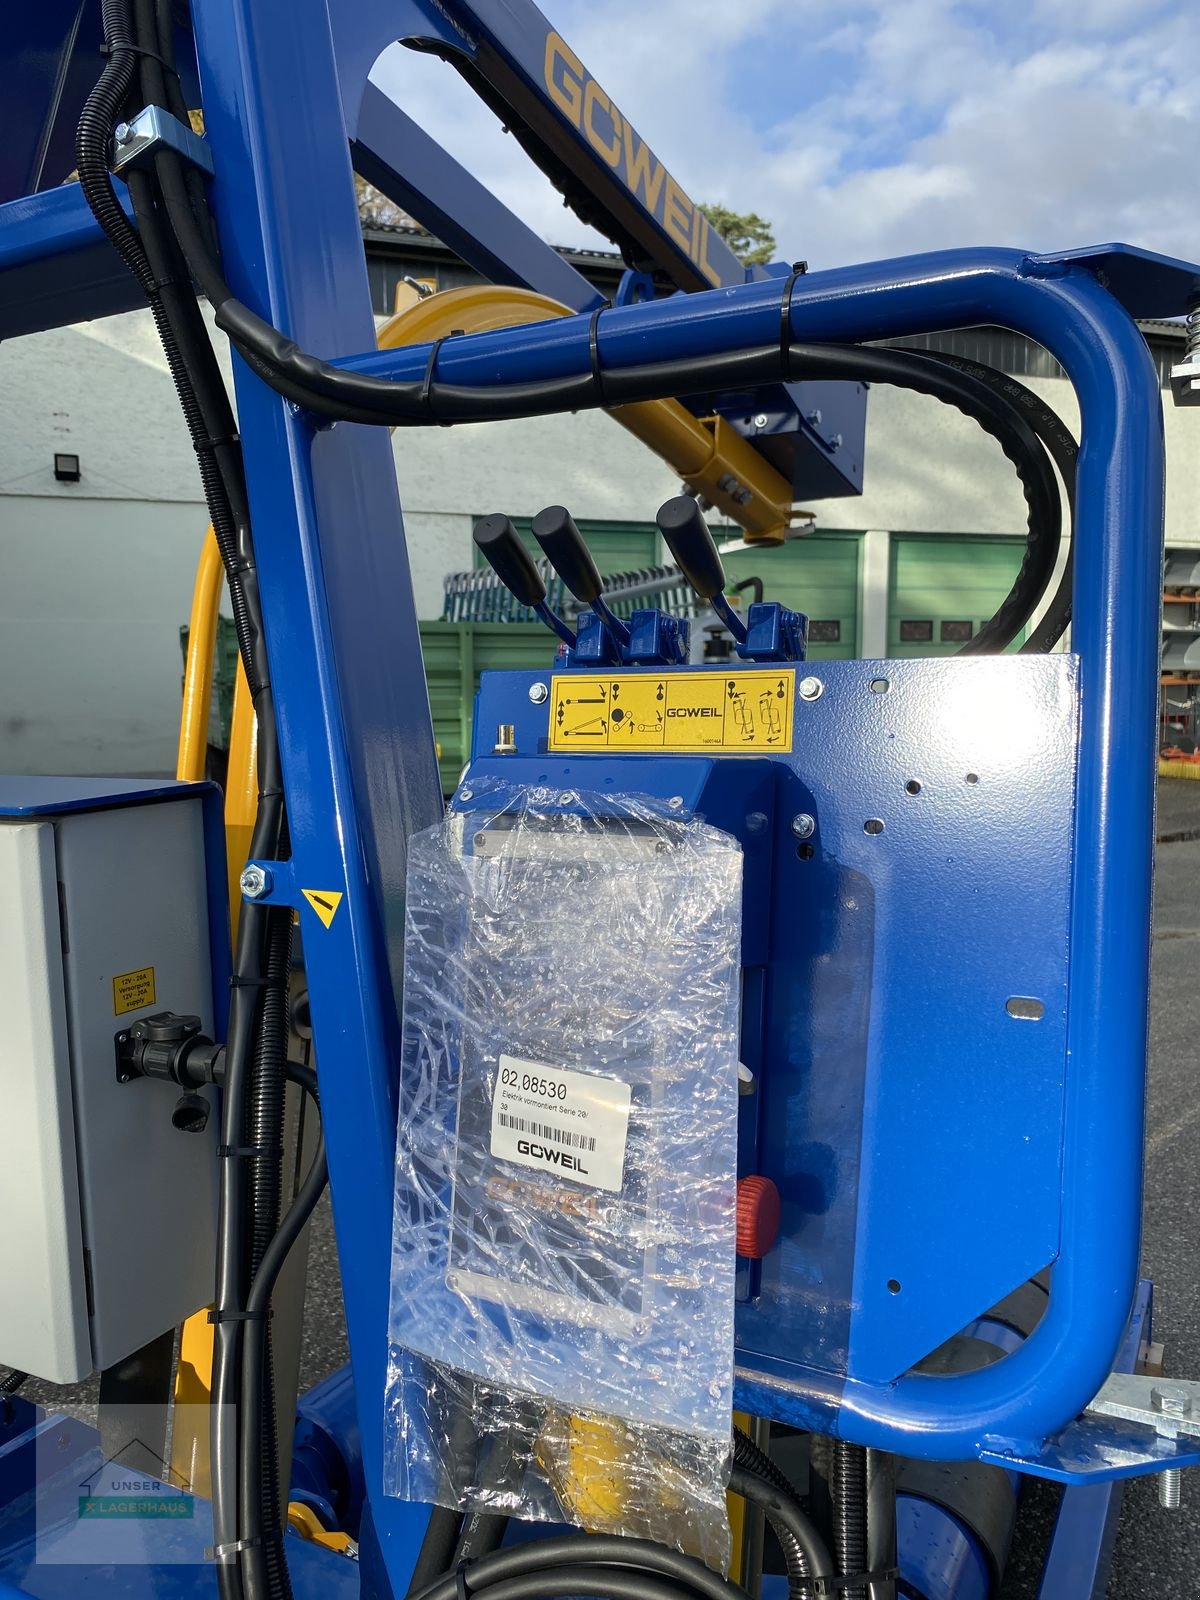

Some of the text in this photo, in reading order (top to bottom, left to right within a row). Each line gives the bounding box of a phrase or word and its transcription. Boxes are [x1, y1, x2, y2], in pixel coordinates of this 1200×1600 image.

[501, 1068, 567, 1100] 02,08530
[500, 1102, 508, 1111] 30
[502, 1090, 523, 1102] Elektrik
[523, 1097, 557, 1112] vormontiert
[559, 1105, 576, 1116] Serie
